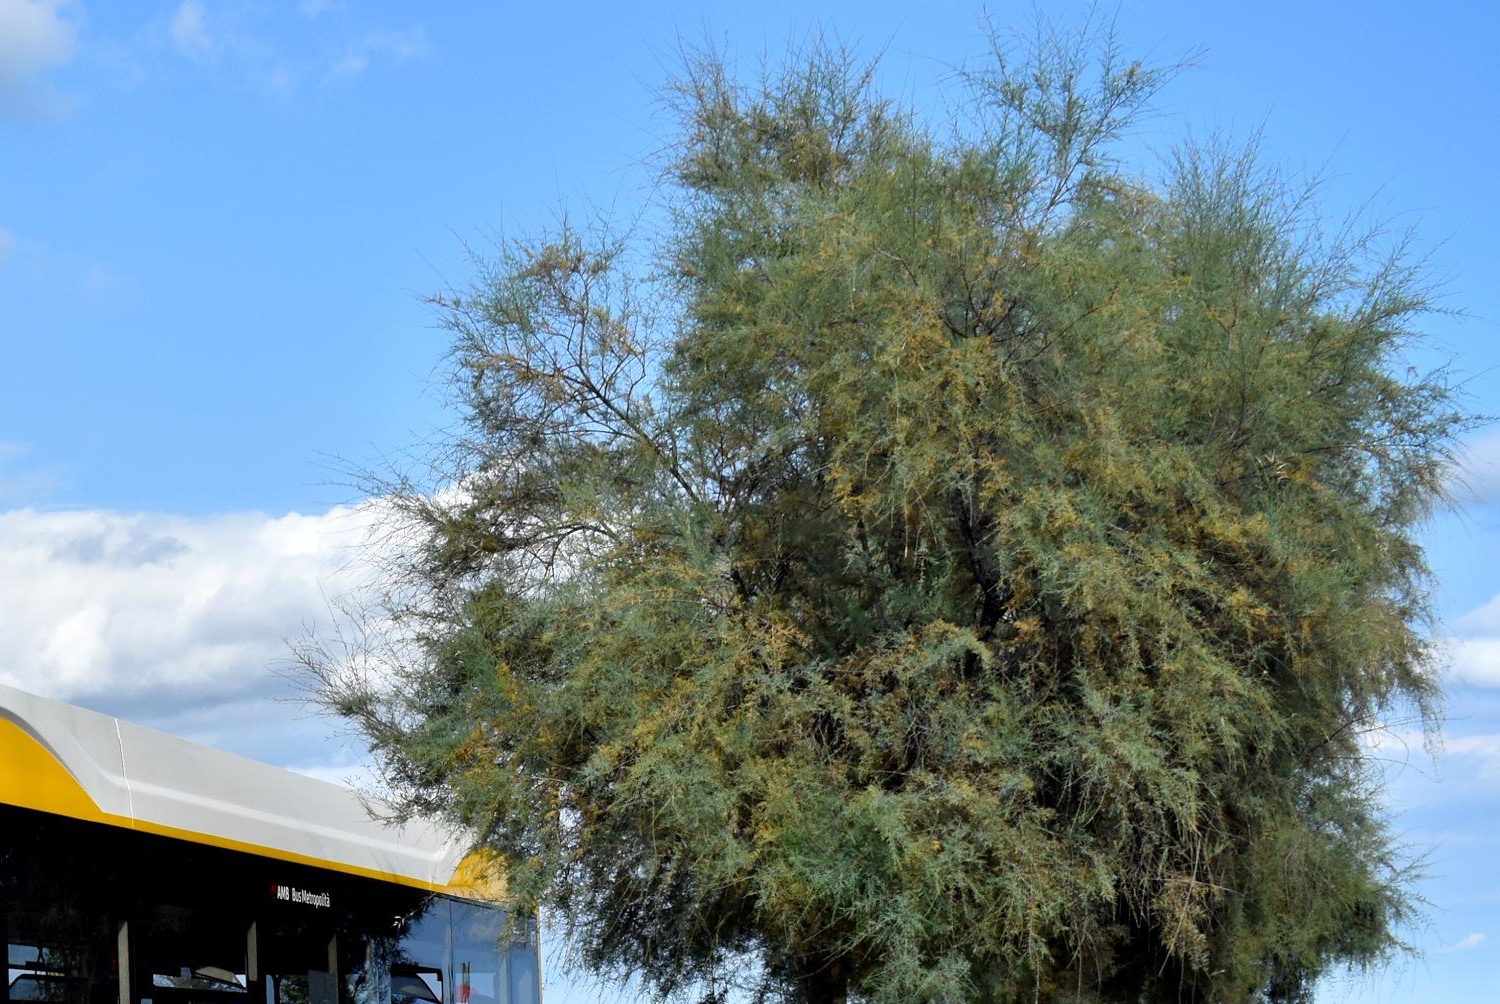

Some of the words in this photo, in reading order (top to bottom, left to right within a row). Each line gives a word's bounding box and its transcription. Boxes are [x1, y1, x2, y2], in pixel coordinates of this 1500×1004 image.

[277, 885, 290, 901] AMB
[291, 887, 302, 903] Bus
[301, 889, 330, 908] Metropolità
